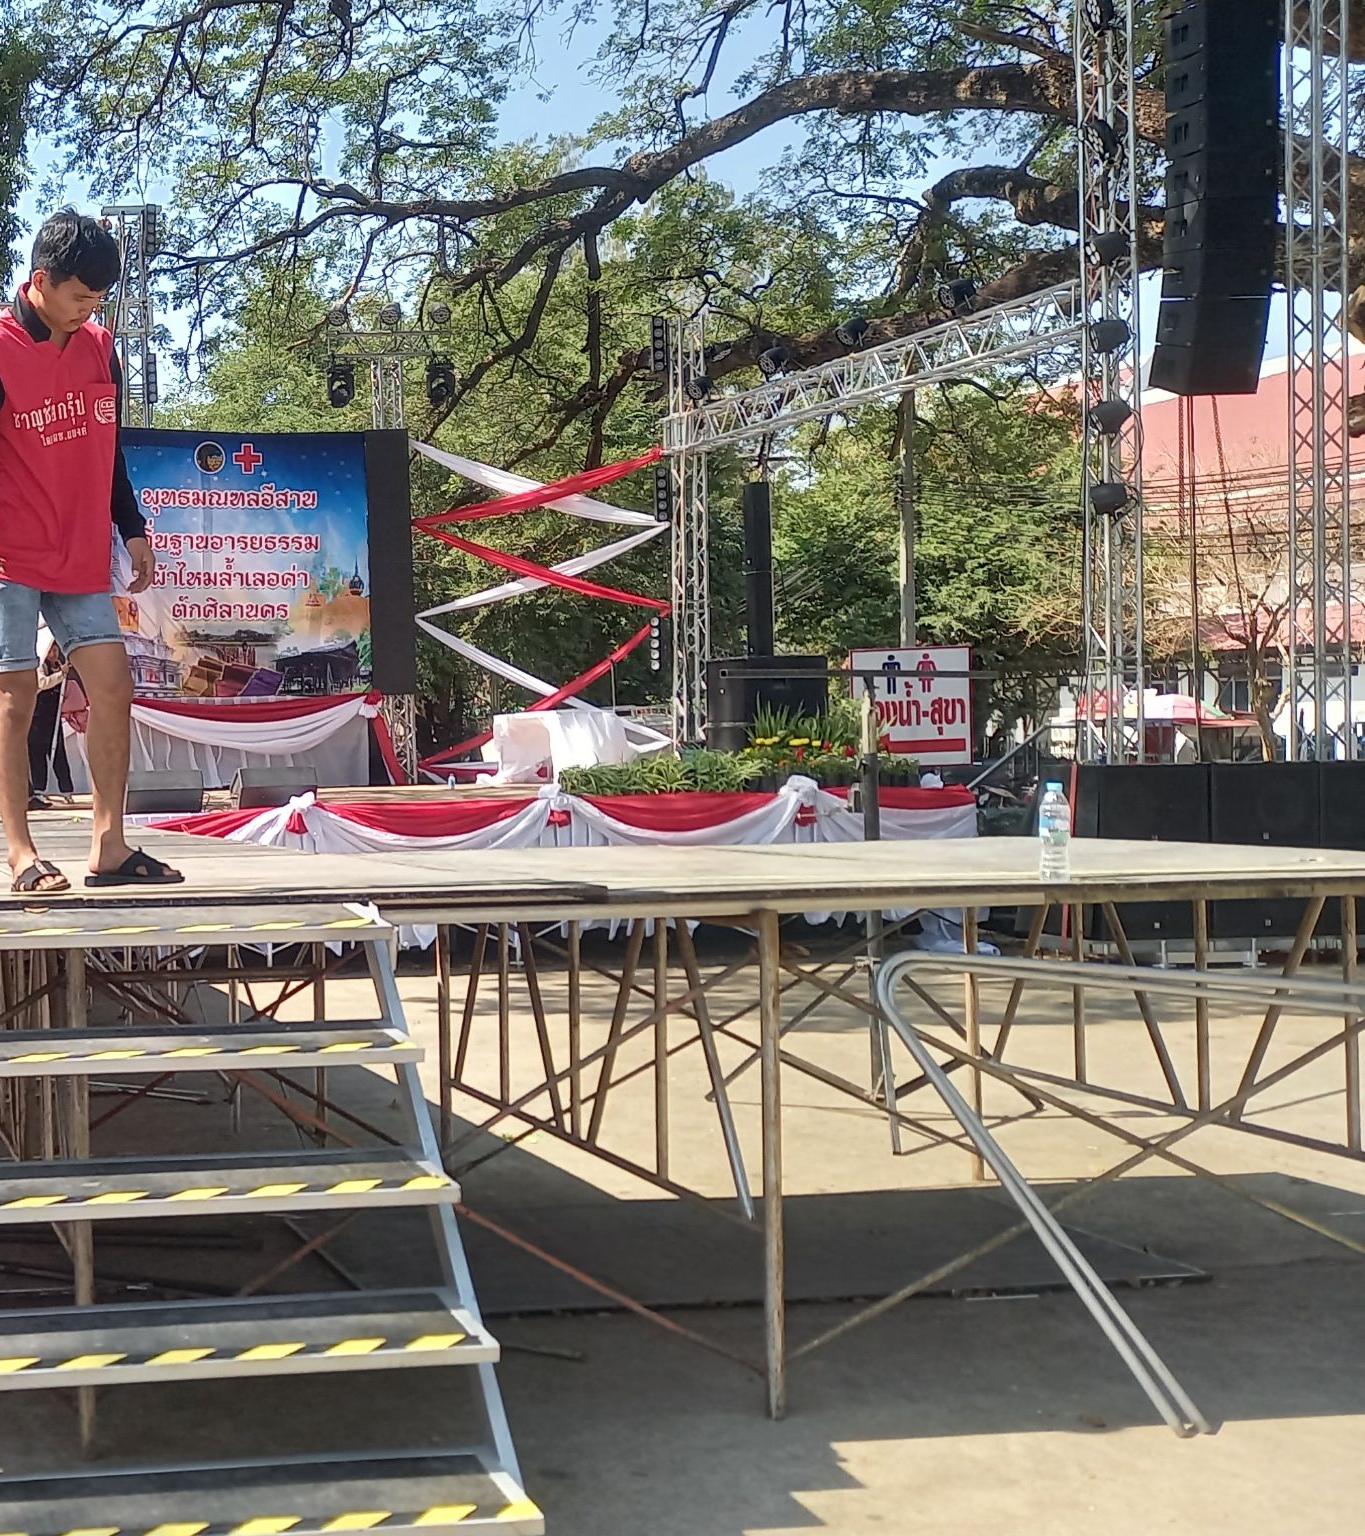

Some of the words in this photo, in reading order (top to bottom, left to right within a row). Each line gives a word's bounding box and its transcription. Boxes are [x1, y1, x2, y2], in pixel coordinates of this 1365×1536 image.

[142, 484, 318, 514] พุทธมณฑลอีสาน
[152, 558, 309, 587] ผ้าไหมล้ำเลอค่า
[171, 595, 289, 619] ตักศิลานคร
[873, 681, 966, 735] องน้ำ-สุขา
